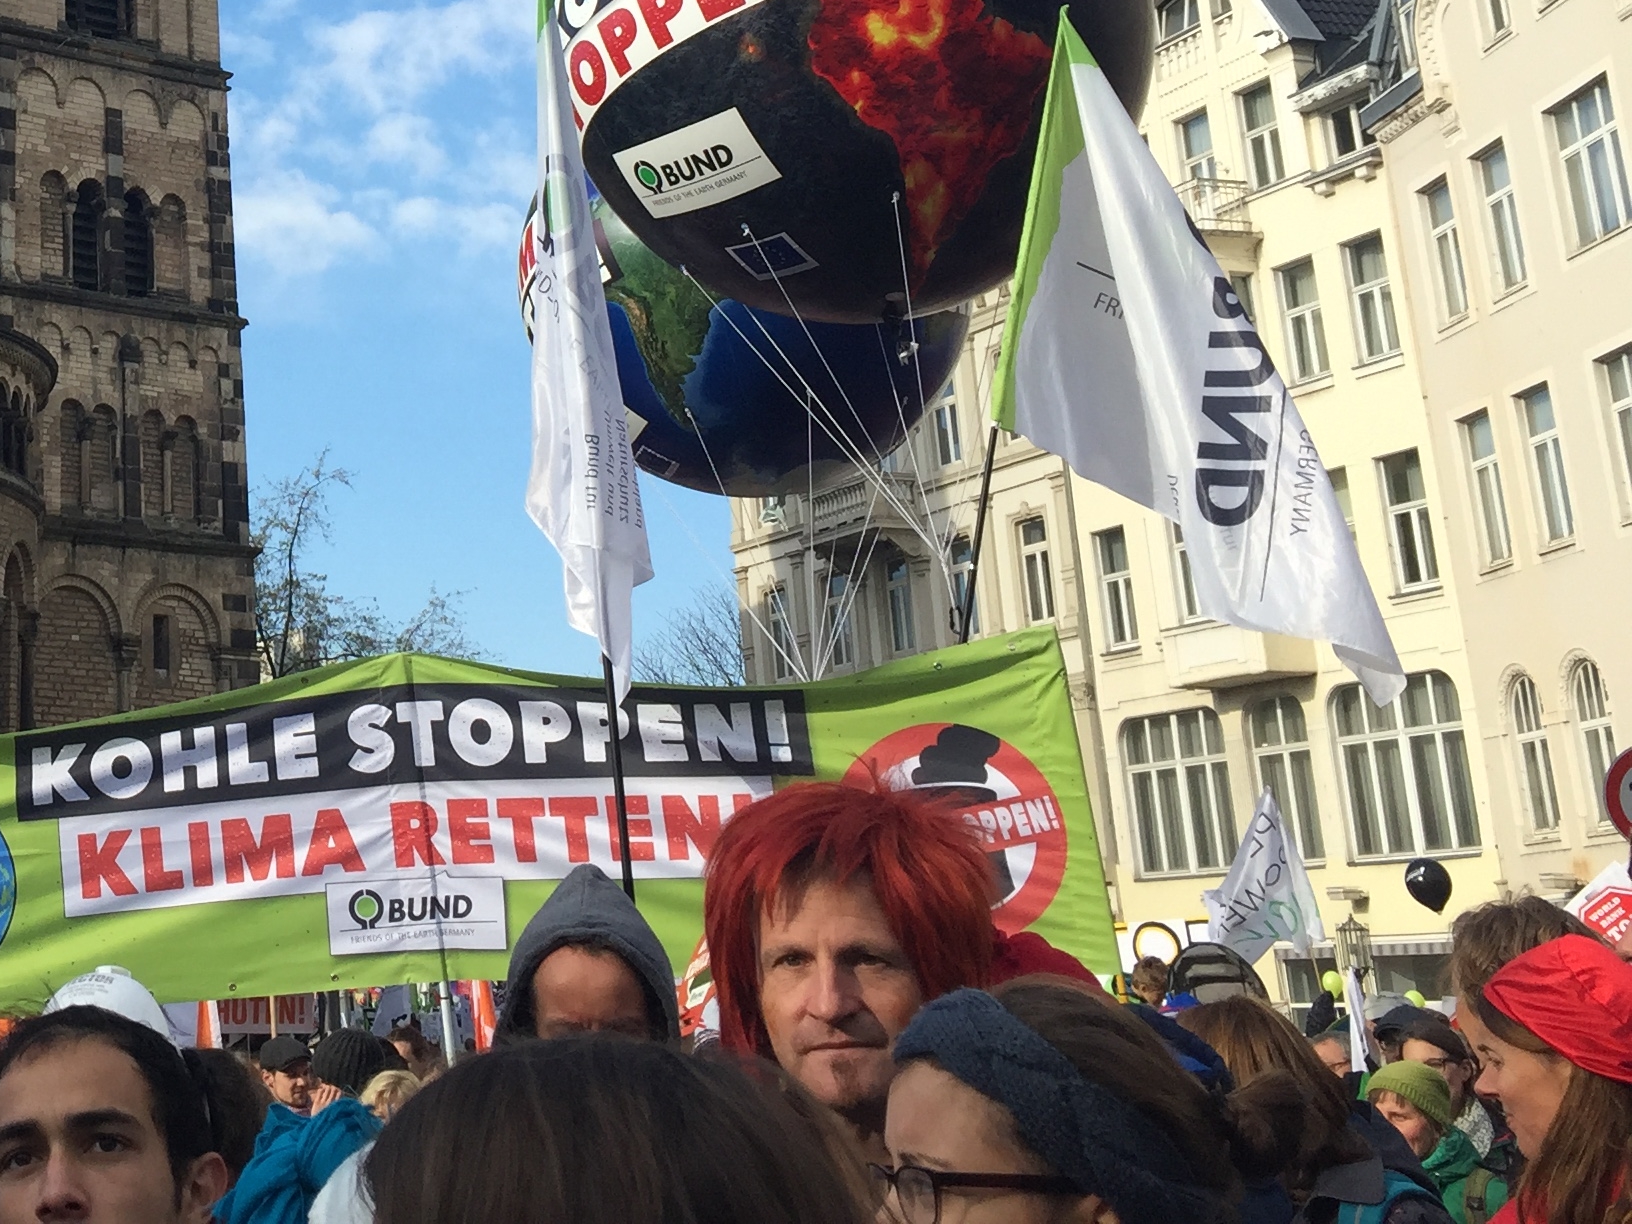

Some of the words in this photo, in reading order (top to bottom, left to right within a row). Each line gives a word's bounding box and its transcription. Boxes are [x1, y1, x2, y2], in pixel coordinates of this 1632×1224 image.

[660, 144, 733, 187] BUND
[682, 189, 695, 198] THE
[714, 170, 748, 188] GERMANY
[31, 712, 320, 806] KOHLE
[347, 697, 792, 774] STOPPEN!
[962, 795, 1060, 844] OPPEN!
[76, 808, 367, 900] KLIMA
[388, 894, 473, 923] BUND
[1588, 897, 1621, 922] WORLD
[1599, 906, 1626, 928] BANK
[350, 933, 382, 944] FRIENDS
